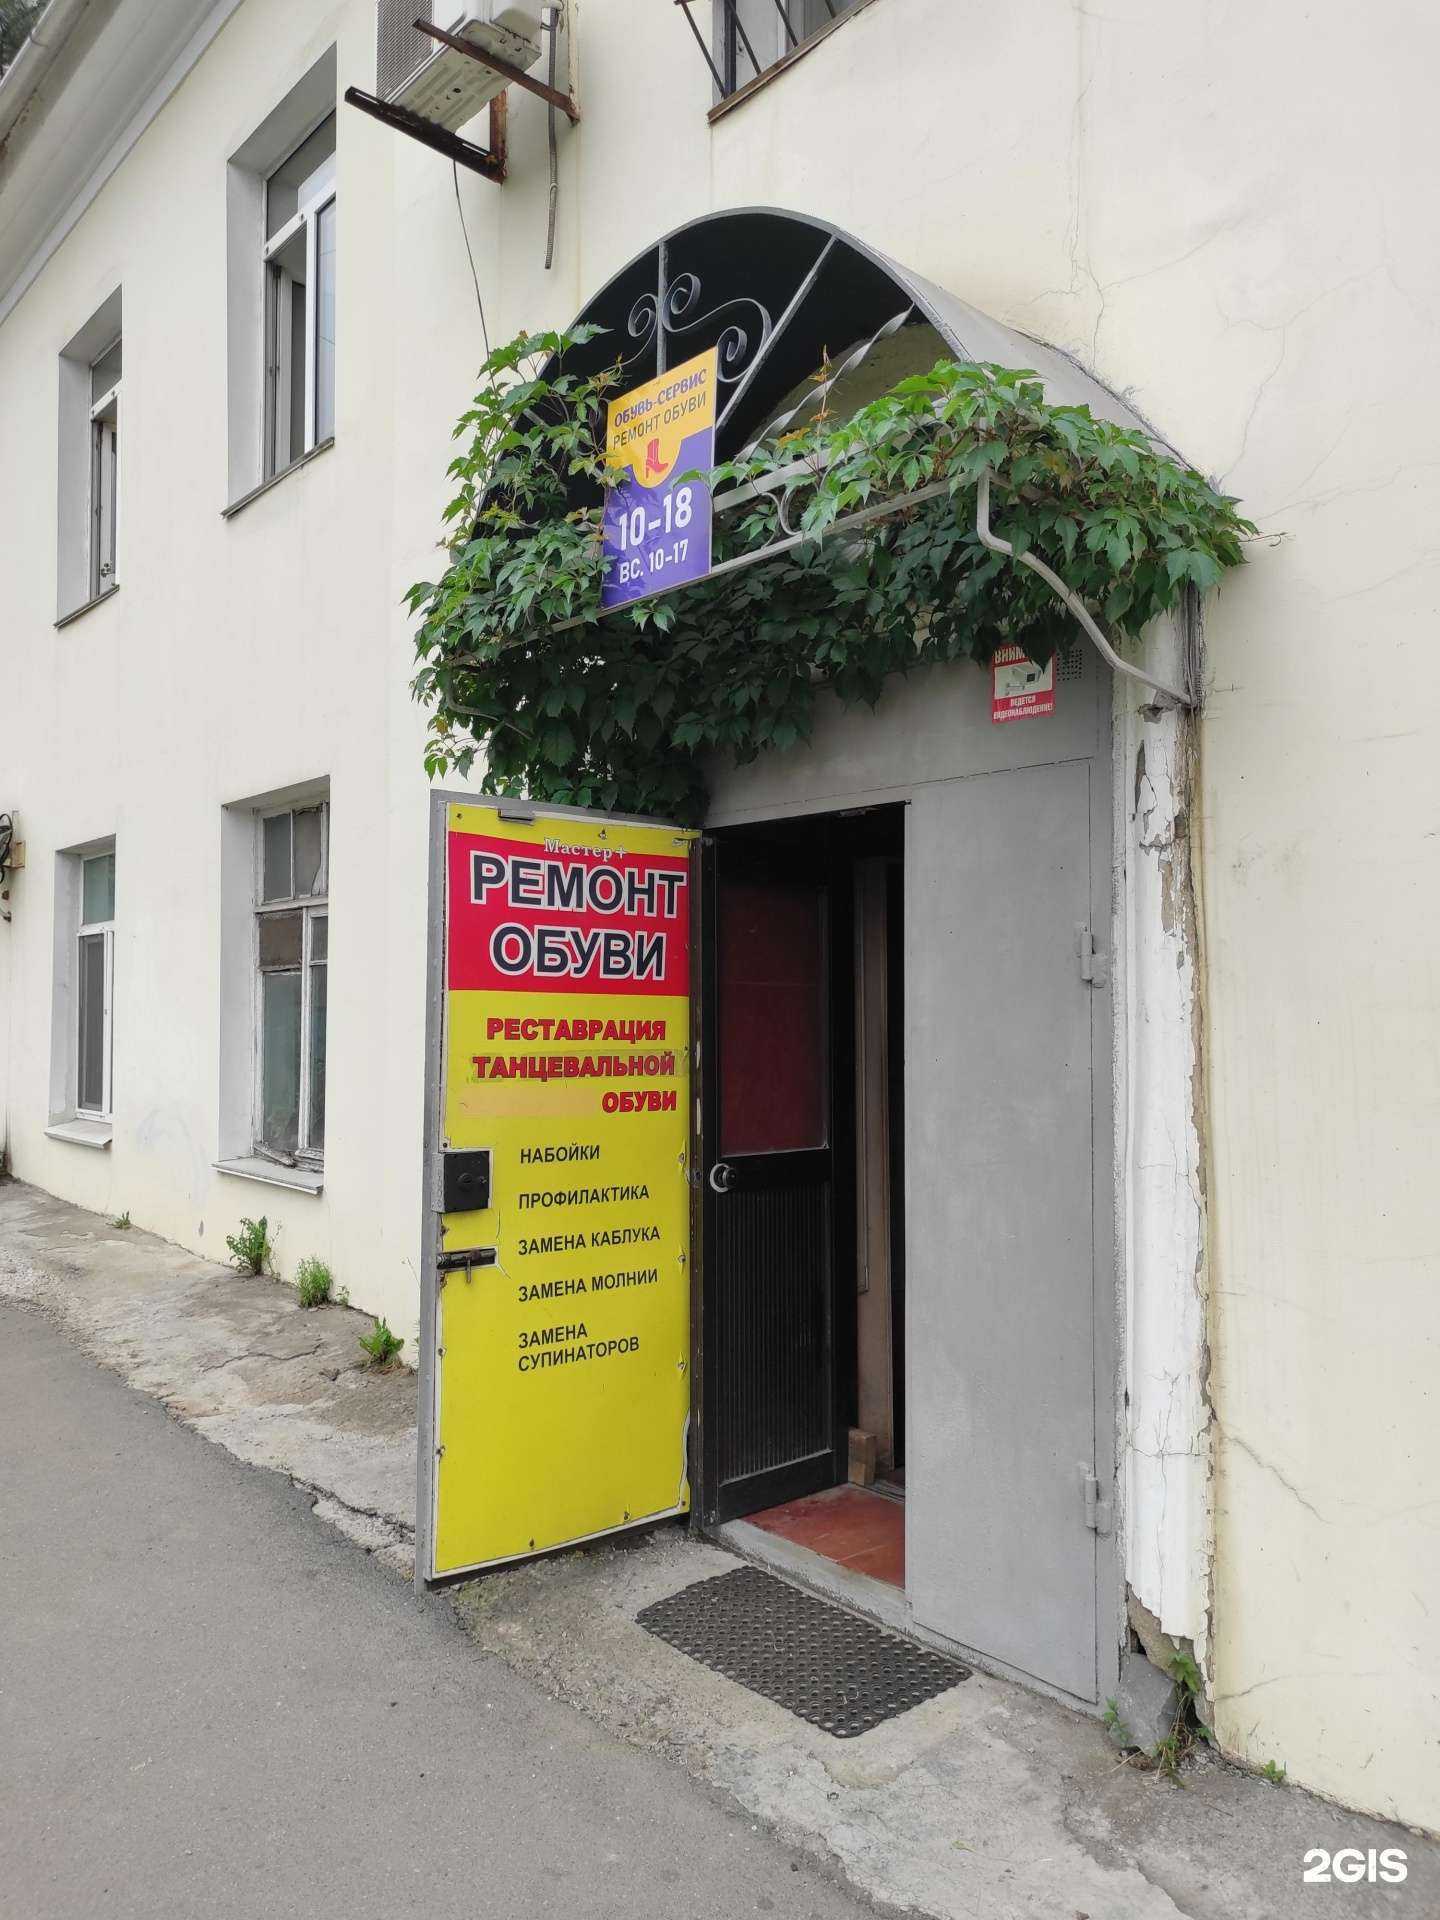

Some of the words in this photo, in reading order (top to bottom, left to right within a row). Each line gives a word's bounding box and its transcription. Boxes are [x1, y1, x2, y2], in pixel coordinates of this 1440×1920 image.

[614, 368, 707, 428] ОБУВЬ-СЕРВИС
[613, 415, 661, 450] РЕМОНТ
[664, 391, 706, 426] ОБУВИ
[619, 487, 692, 551] 10-18
[620, 558, 644, 584] ВС.
[649, 539, 688, 573] 10-17
[469, 850, 688, 918] РЕМОНТ
[489, 922, 666, 980] ОБУВИ
[486, 1017, 666, 1044] РЕСТАВРАЦИЯ
[472, 1051, 676, 1082] ТАНЦЕВАЛЬНОЙ
[601, 1090, 677, 1113] ОБУВИ
[520, 1142, 600, 1164] НАБОЙКИ
[518, 1184, 649, 1209] ПРОФИЛАКТИКА
[518, 1234, 586, 1256] ЗАМЕНА
[591, 1226, 661, 1247] КАБЛУКА
[518, 1278, 587, 1302] ЗАМЕНА
[591, 1268, 658, 1292] МОЛНИИ
[518, 1322, 588, 1349] ЗАМЕНА
[518, 1336, 640, 1372] СУПИНАТОРОВ
